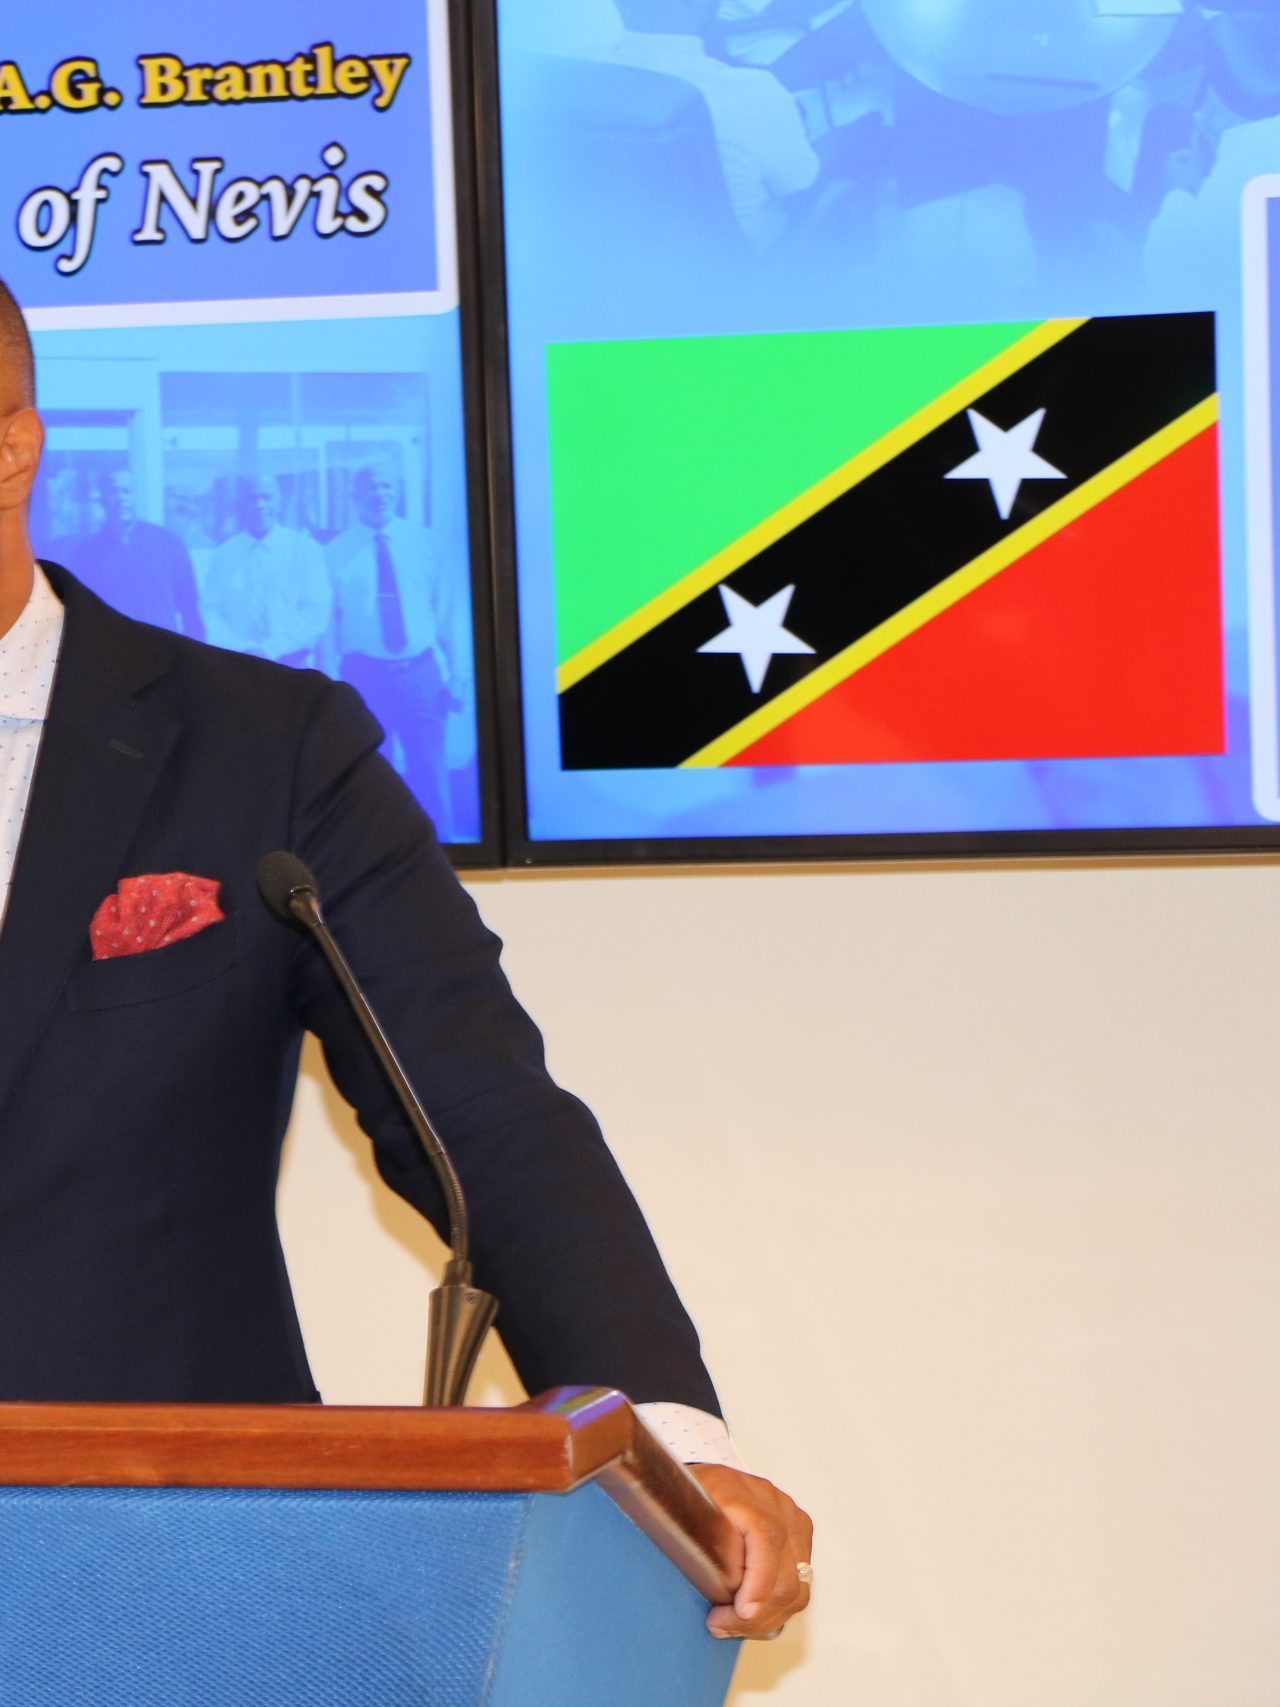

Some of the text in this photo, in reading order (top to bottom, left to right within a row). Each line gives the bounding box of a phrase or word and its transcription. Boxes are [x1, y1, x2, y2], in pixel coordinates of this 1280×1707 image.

[137, 42, 411, 112] Brantley
[18, 152, 123, 276] of
[132, 141, 388, 243] Nevis
